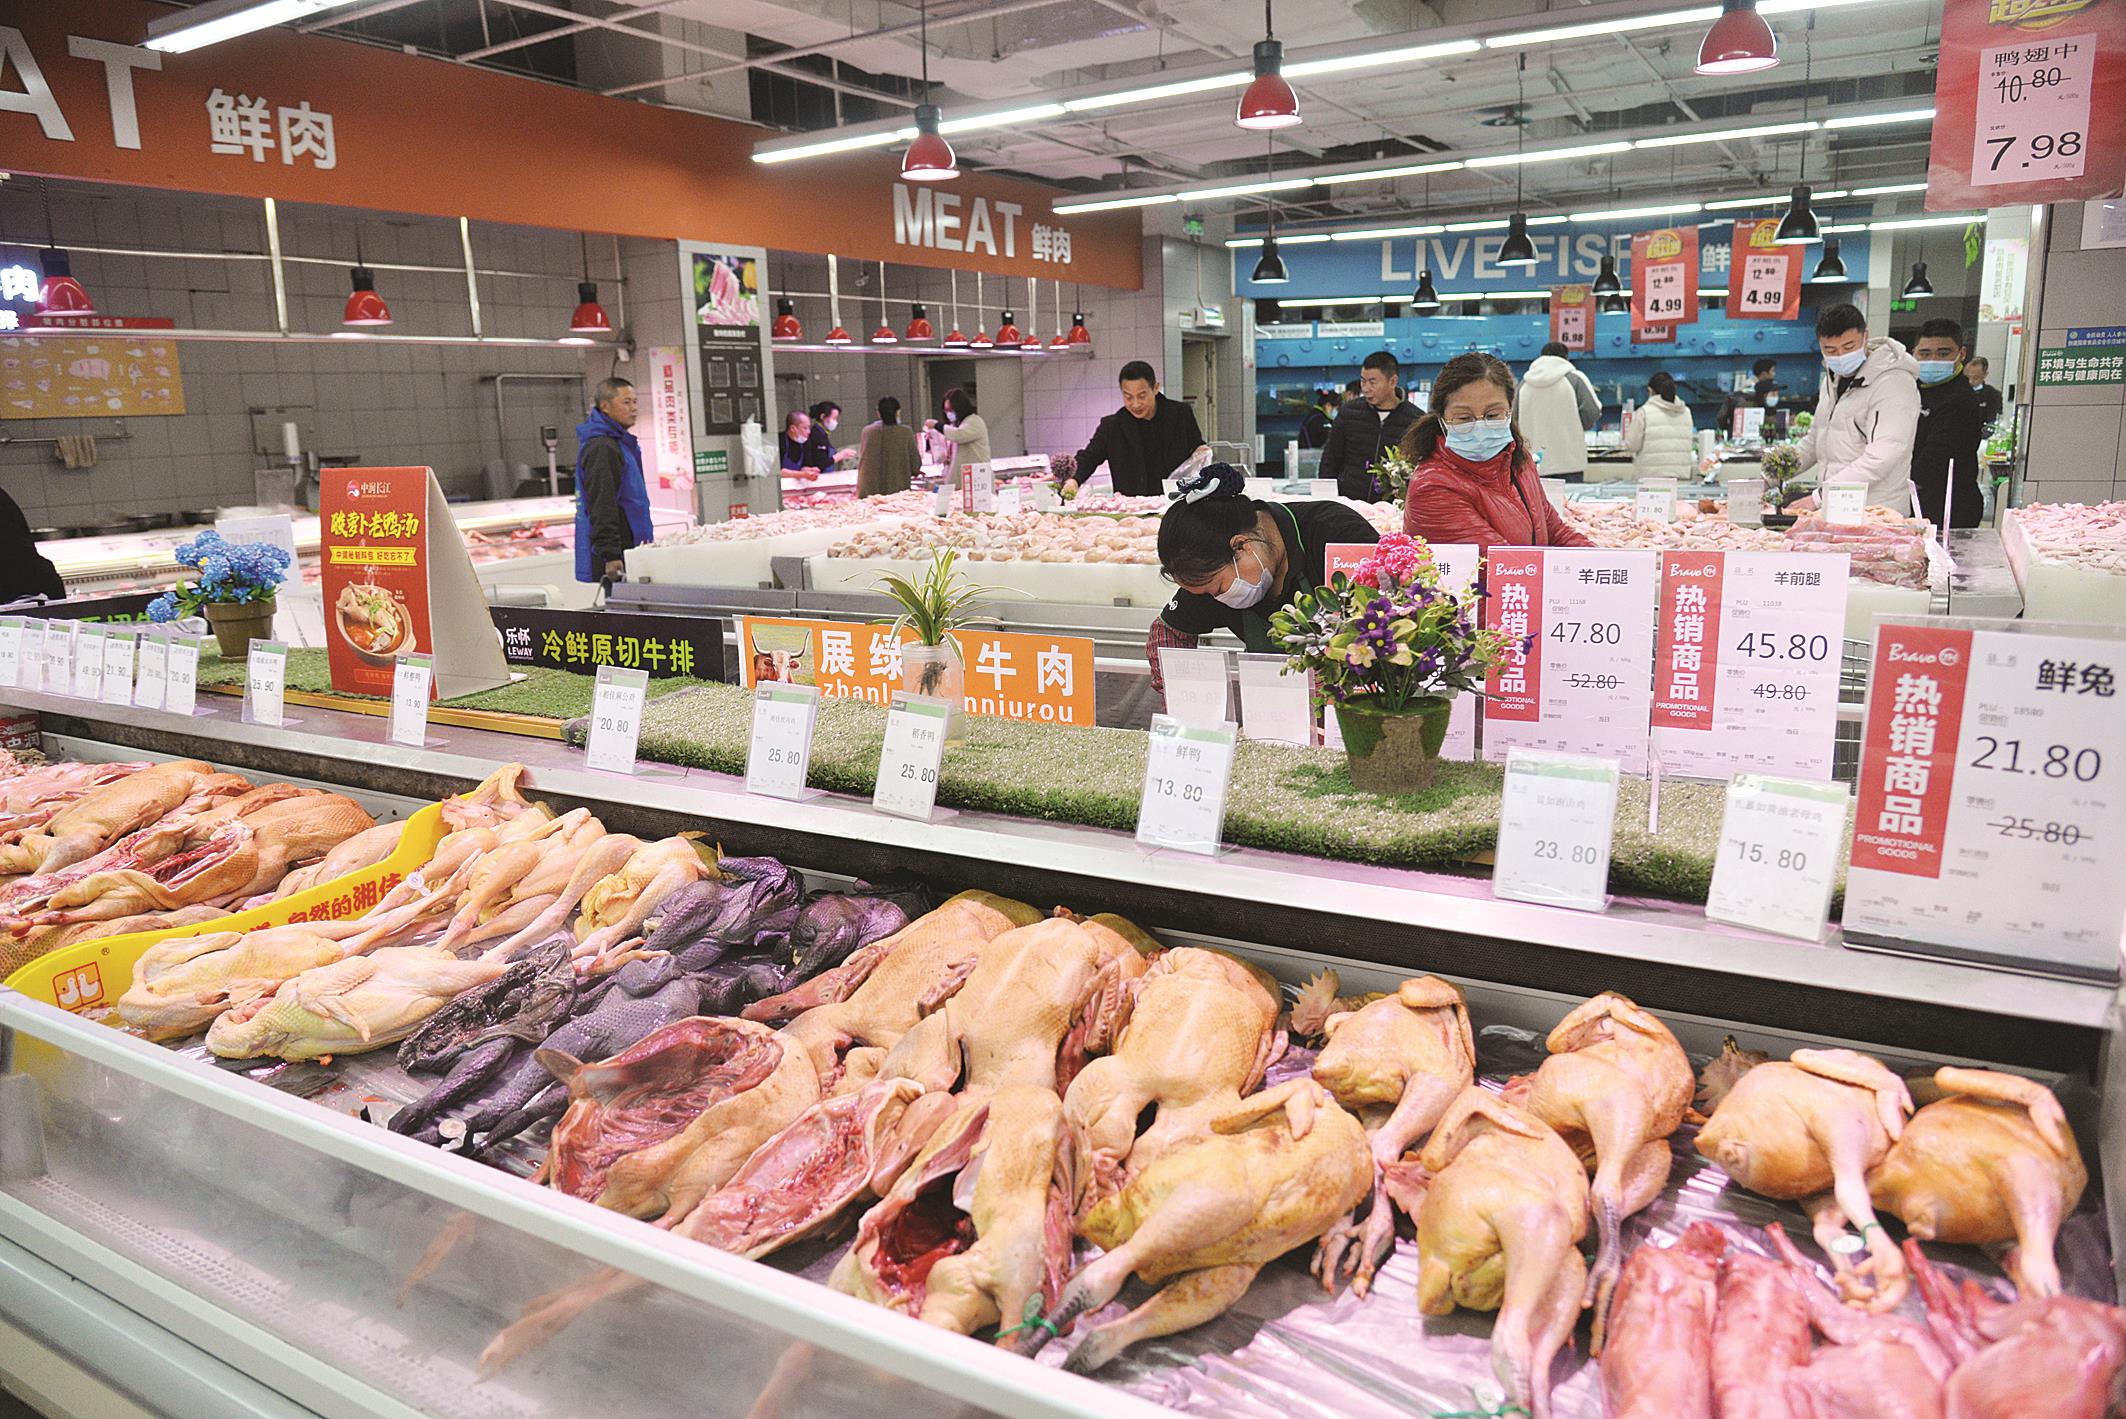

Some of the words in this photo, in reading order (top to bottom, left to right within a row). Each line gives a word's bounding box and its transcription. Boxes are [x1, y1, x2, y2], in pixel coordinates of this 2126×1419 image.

[1994, 43, 2078, 68] 鸭翅中
[1998, 67, 2062, 104] 10.80
[206, 88, 337, 169] 鲜肉
[1986, 131, 2081, 171] 7.98
[893, 183, 1022, 258] MEAT
[1031, 222, 1072, 265] 鲜肉
[1381, 235, 1508, 281] LIVE
[1702, 243, 1731, 273] 鲜
[1650, 298, 1682, 313] 4.99
[1746, 289, 1781, 304] 4.99
[2040, 356, 2124, 370] 环境与生命共存
[2039, 369, 2122, 382] 环保与健康同在
[330, 509, 420, 539] 酸萝卜老鸭汤
[1495, 563, 1524, 576] Bravo
[1578, 568, 1629, 585] 羊后腿
[1669, 563, 1702, 577] Bravo
[1774, 571, 1821, 586] 羊前腿
[1550, 622, 1621, 645] 47.80
[1669, 584, 1707, 701] 热销商品
[508, 646, 533, 657] LEWAY
[541, 628, 696, 673] 冷鲜原切牛排
[1736, 632, 1829, 661] 45.80
[1888, 643, 1938, 664] Bravo
[820, 629, 1074, 698] 展绿牛肉
[1570, 673, 1617, 690] 52.80
[2035, 658, 2116, 697] 鲜兔
[1753, 683, 1807, 701] 49.80
[1500, 703, 1525, 711] GOODS
[1656, 702, 1710, 713] PROMOTIONAL
[1669, 710, 1697, 719] GOODS
[600, 717, 629, 733] 20.80
[768, 747, 801, 766] 25.80
[1878, 672, 1943, 836] 热销商品
[1970, 736, 2101, 782] 21.80
[901, 763, 936, 784] 25.80
[1156, 777, 1204, 803] 13.80
[1999, 816, 2080, 846] 25.80
[1534, 839, 1597, 865] 23.80
[1857, 833, 1937, 853] PROMOTIONAL
[1877, 846, 1918, 860] GOODS
[1737, 841, 1807, 871] 15.80
